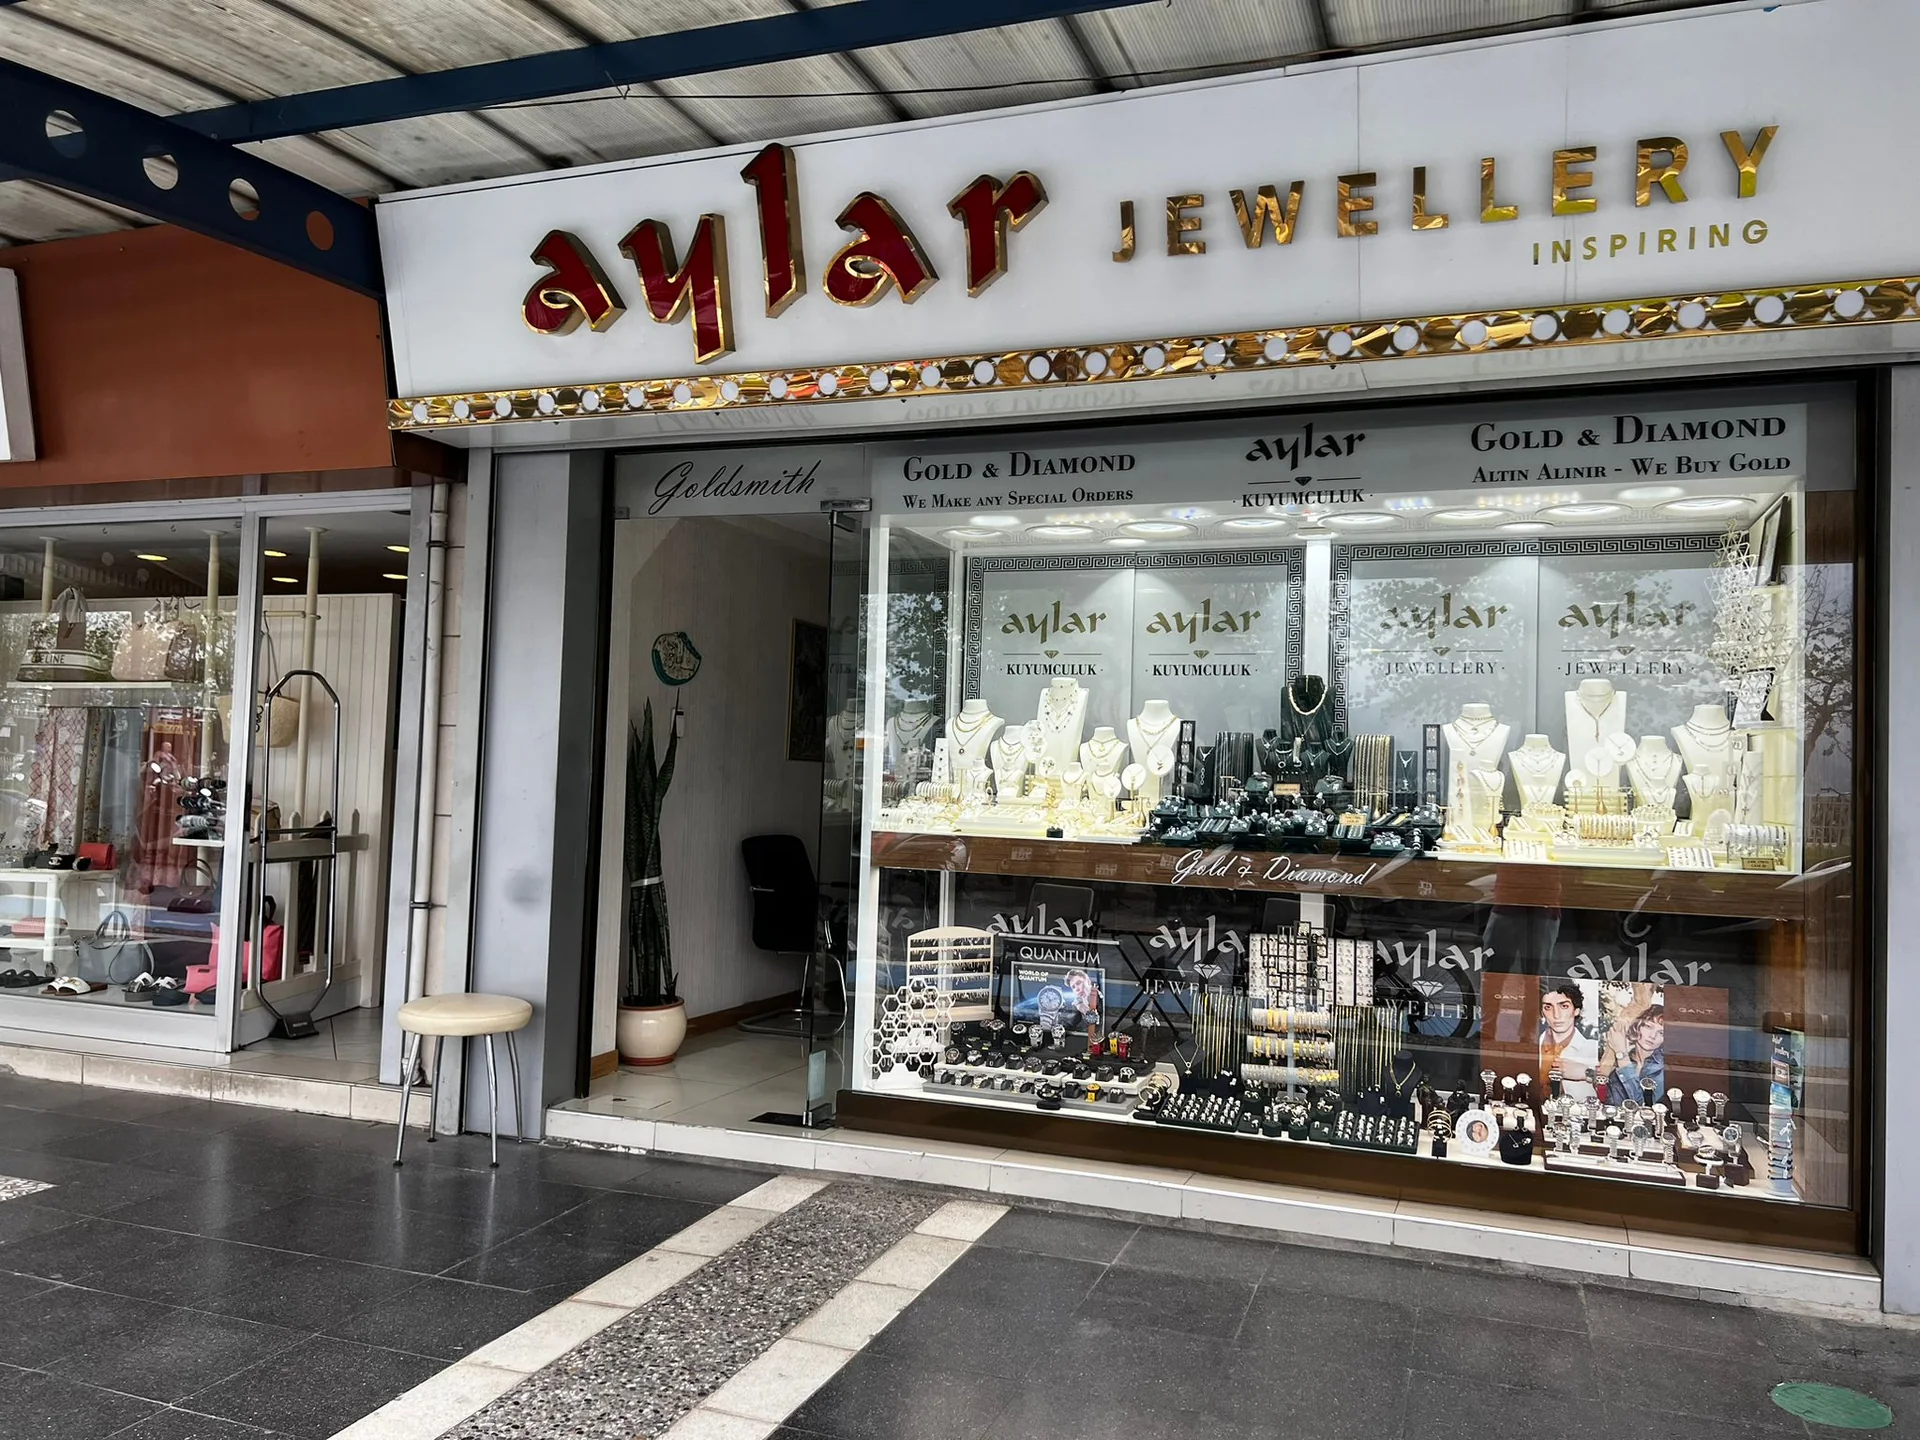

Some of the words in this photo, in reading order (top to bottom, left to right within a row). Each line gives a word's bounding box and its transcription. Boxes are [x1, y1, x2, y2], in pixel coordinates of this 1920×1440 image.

[1112, 125, 1780, 263] JEWELLERY
[522, 142, 1050, 365] aylar
[1532, 218, 1769, 266] INSPIRING
[1244, 422, 1366, 472] aylar
[1470, 422, 1565, 454] GOLD
[1576, 428, 1600, 447] &
[1613, 415, 1787, 446] DIAMOND
[903, 456, 974, 483] GOLD
[982, 462, 999, 479] &
[1008, 451, 1137, 477] DIAMOND
[1729, 454, 1792, 473] GOLD
[648, 459, 823, 516] Goldsmith
[1241, 488, 1366, 509] KUYUMCULUK
[1000, 600, 1107, 644] aylar
[1145, 598, 1262, 644] aylar
[1379, 592, 1509, 640] aylar
[1557, 590, 1697, 640] aylar
[1006, 663, 1098, 676] KUYUMCULUK
[1152, 663, 1252, 676] KUYUMCULUK
[1384, 661, 1498, 675] JEWELLERY
[1564, 661, 1687, 676] JEWELLERY
[1171, 849, 1238, 885] Gold
[1262, 855, 1377, 885] Diamond
[1019, 946, 1102, 965] QUANTUM
[1149, 914, 1246, 963] ayla
[1018, 969, 1040, 977] WORLD
[1018, 974, 1048, 983] QUANTUM
